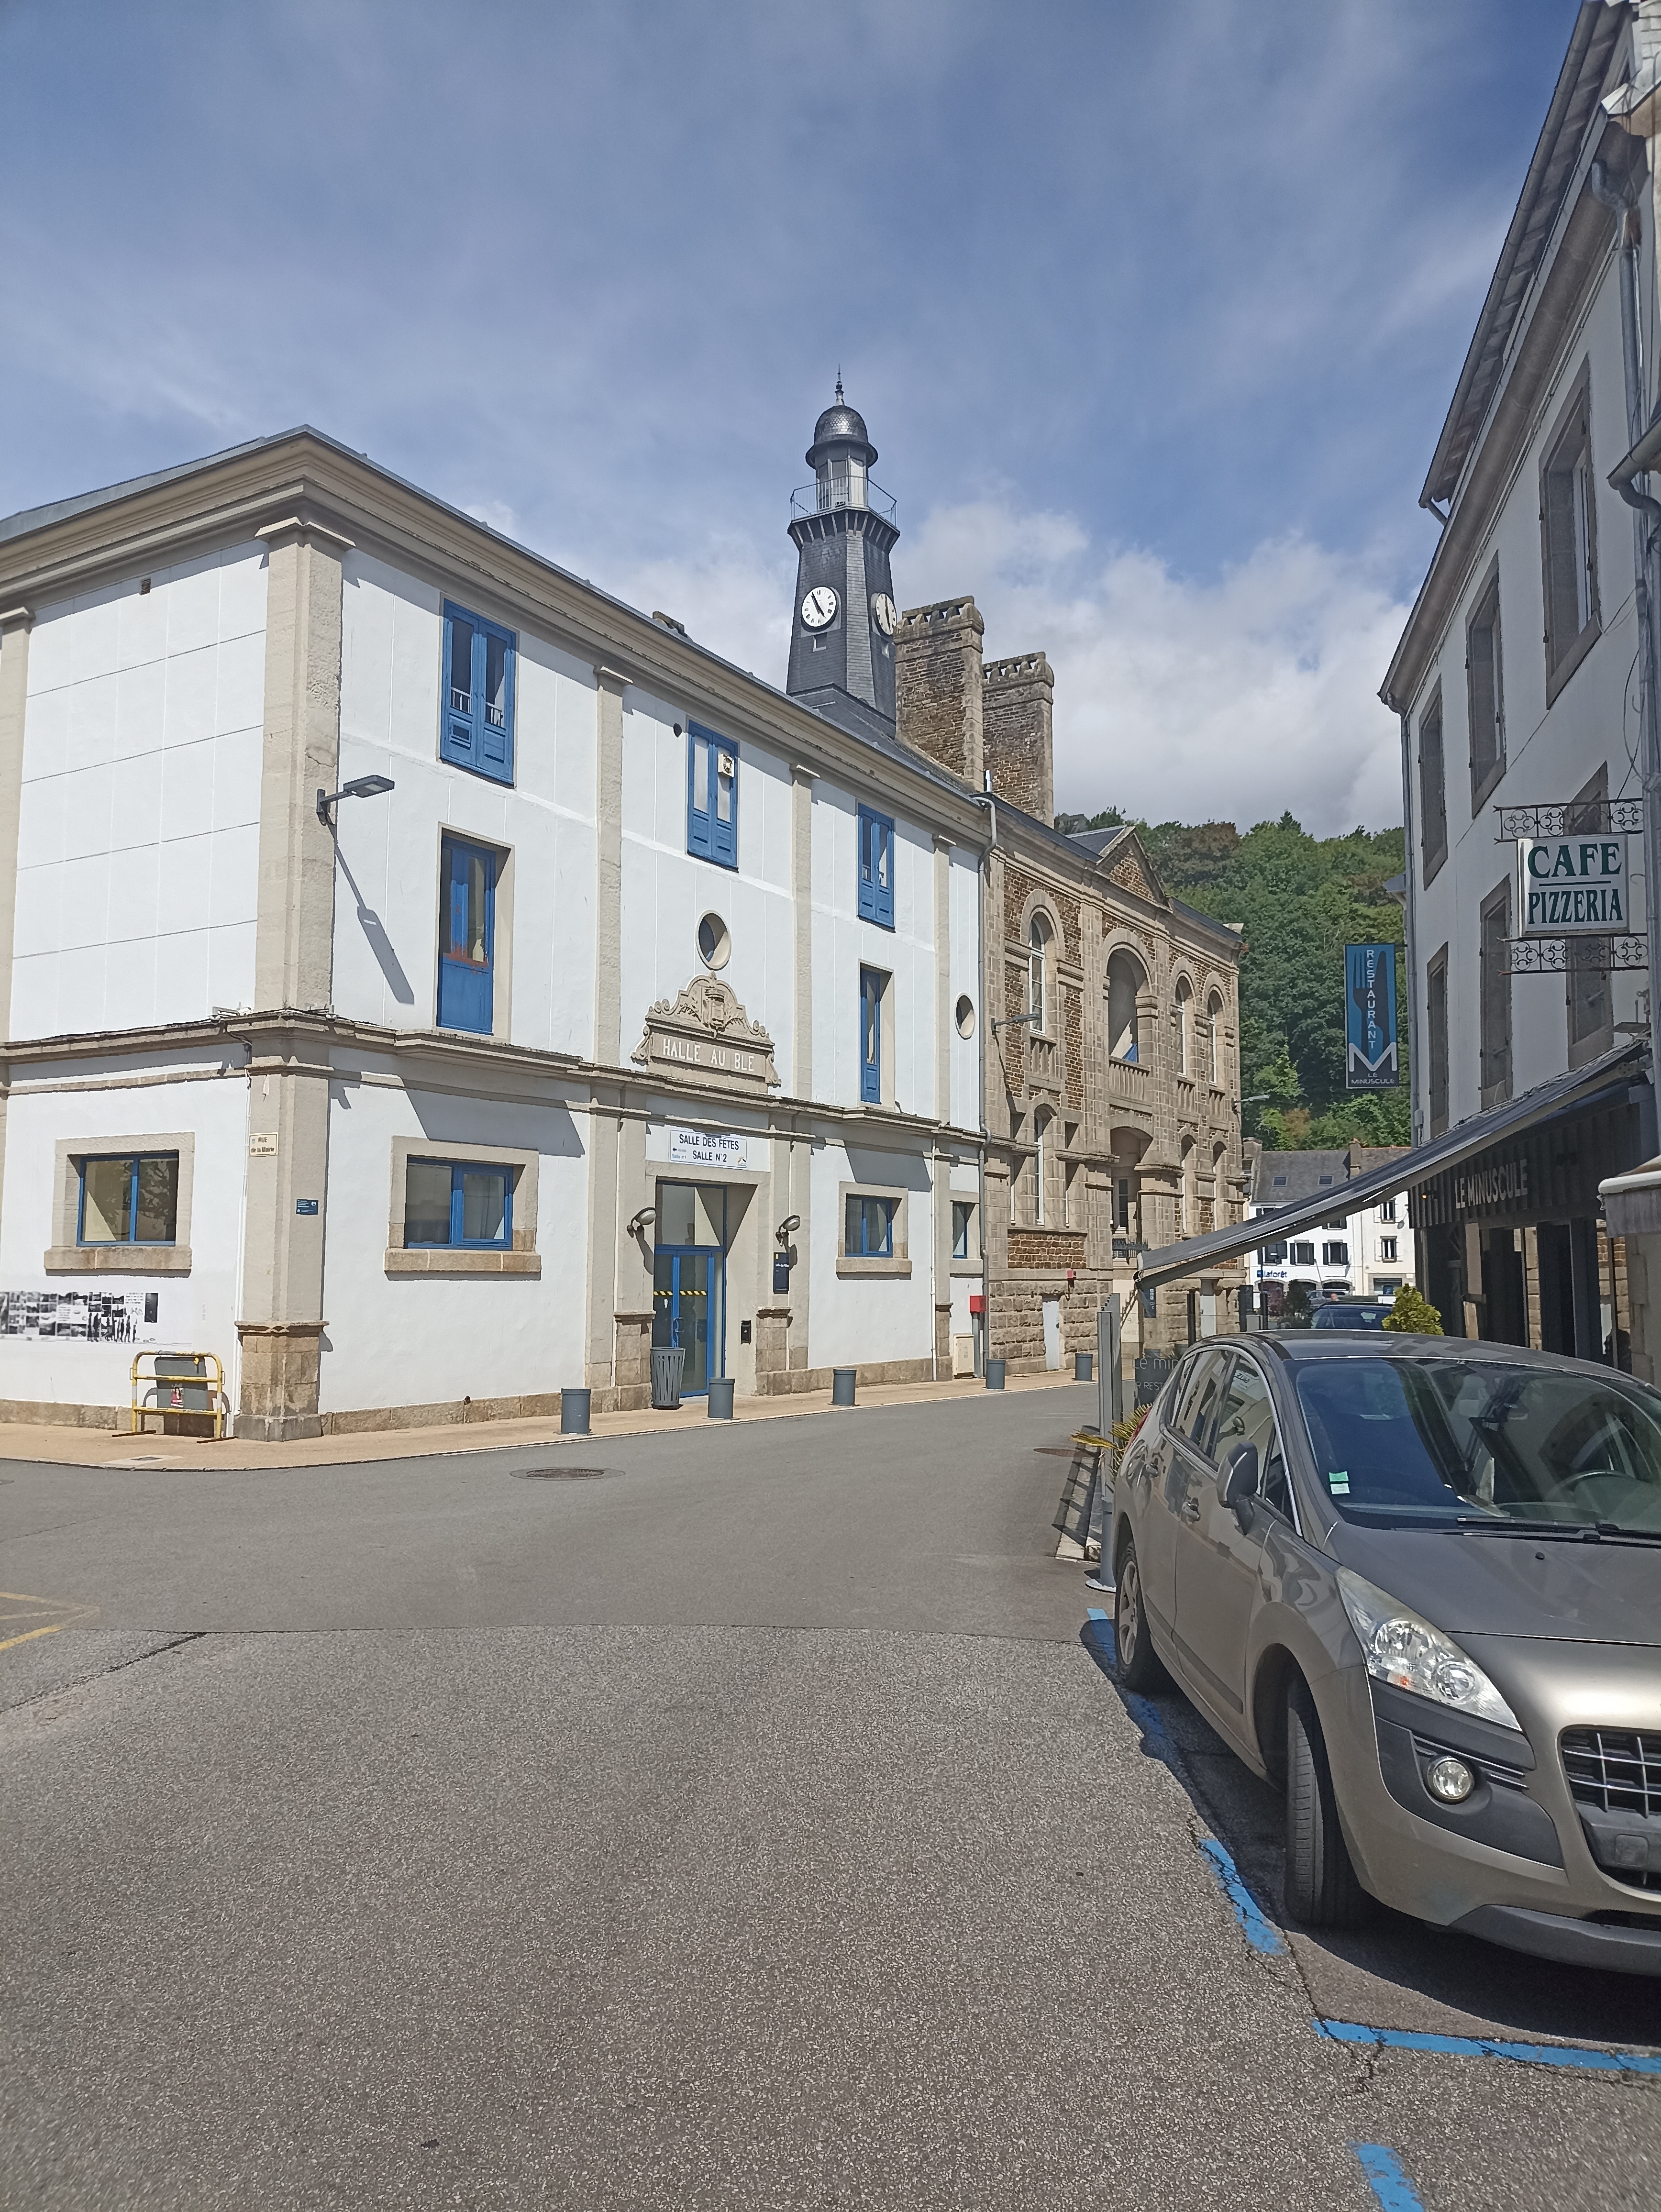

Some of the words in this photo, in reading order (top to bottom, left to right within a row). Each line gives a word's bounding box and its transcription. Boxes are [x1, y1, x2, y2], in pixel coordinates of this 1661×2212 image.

[1528, 842, 1622, 879] CAFE
[1528, 889, 1623, 924] PIZZERIA
[1366, 950, 1376, 1049] RESTAURANT
[663, 1038, 700, 1062] HALLE
[711, 1049, 725, 1066] AU
[734, 1052, 754, 1072] BLE
[679, 1134, 699, 1145] SALLE
[703, 1137, 716, 1148] DES
[719, 1138, 739, 1150] FÊTES
[692, 1150, 712, 1161] SALLE
[1455, 1177, 1465, 1209] LE
[1467, 1158, 1528, 1206] MINUSCULE
